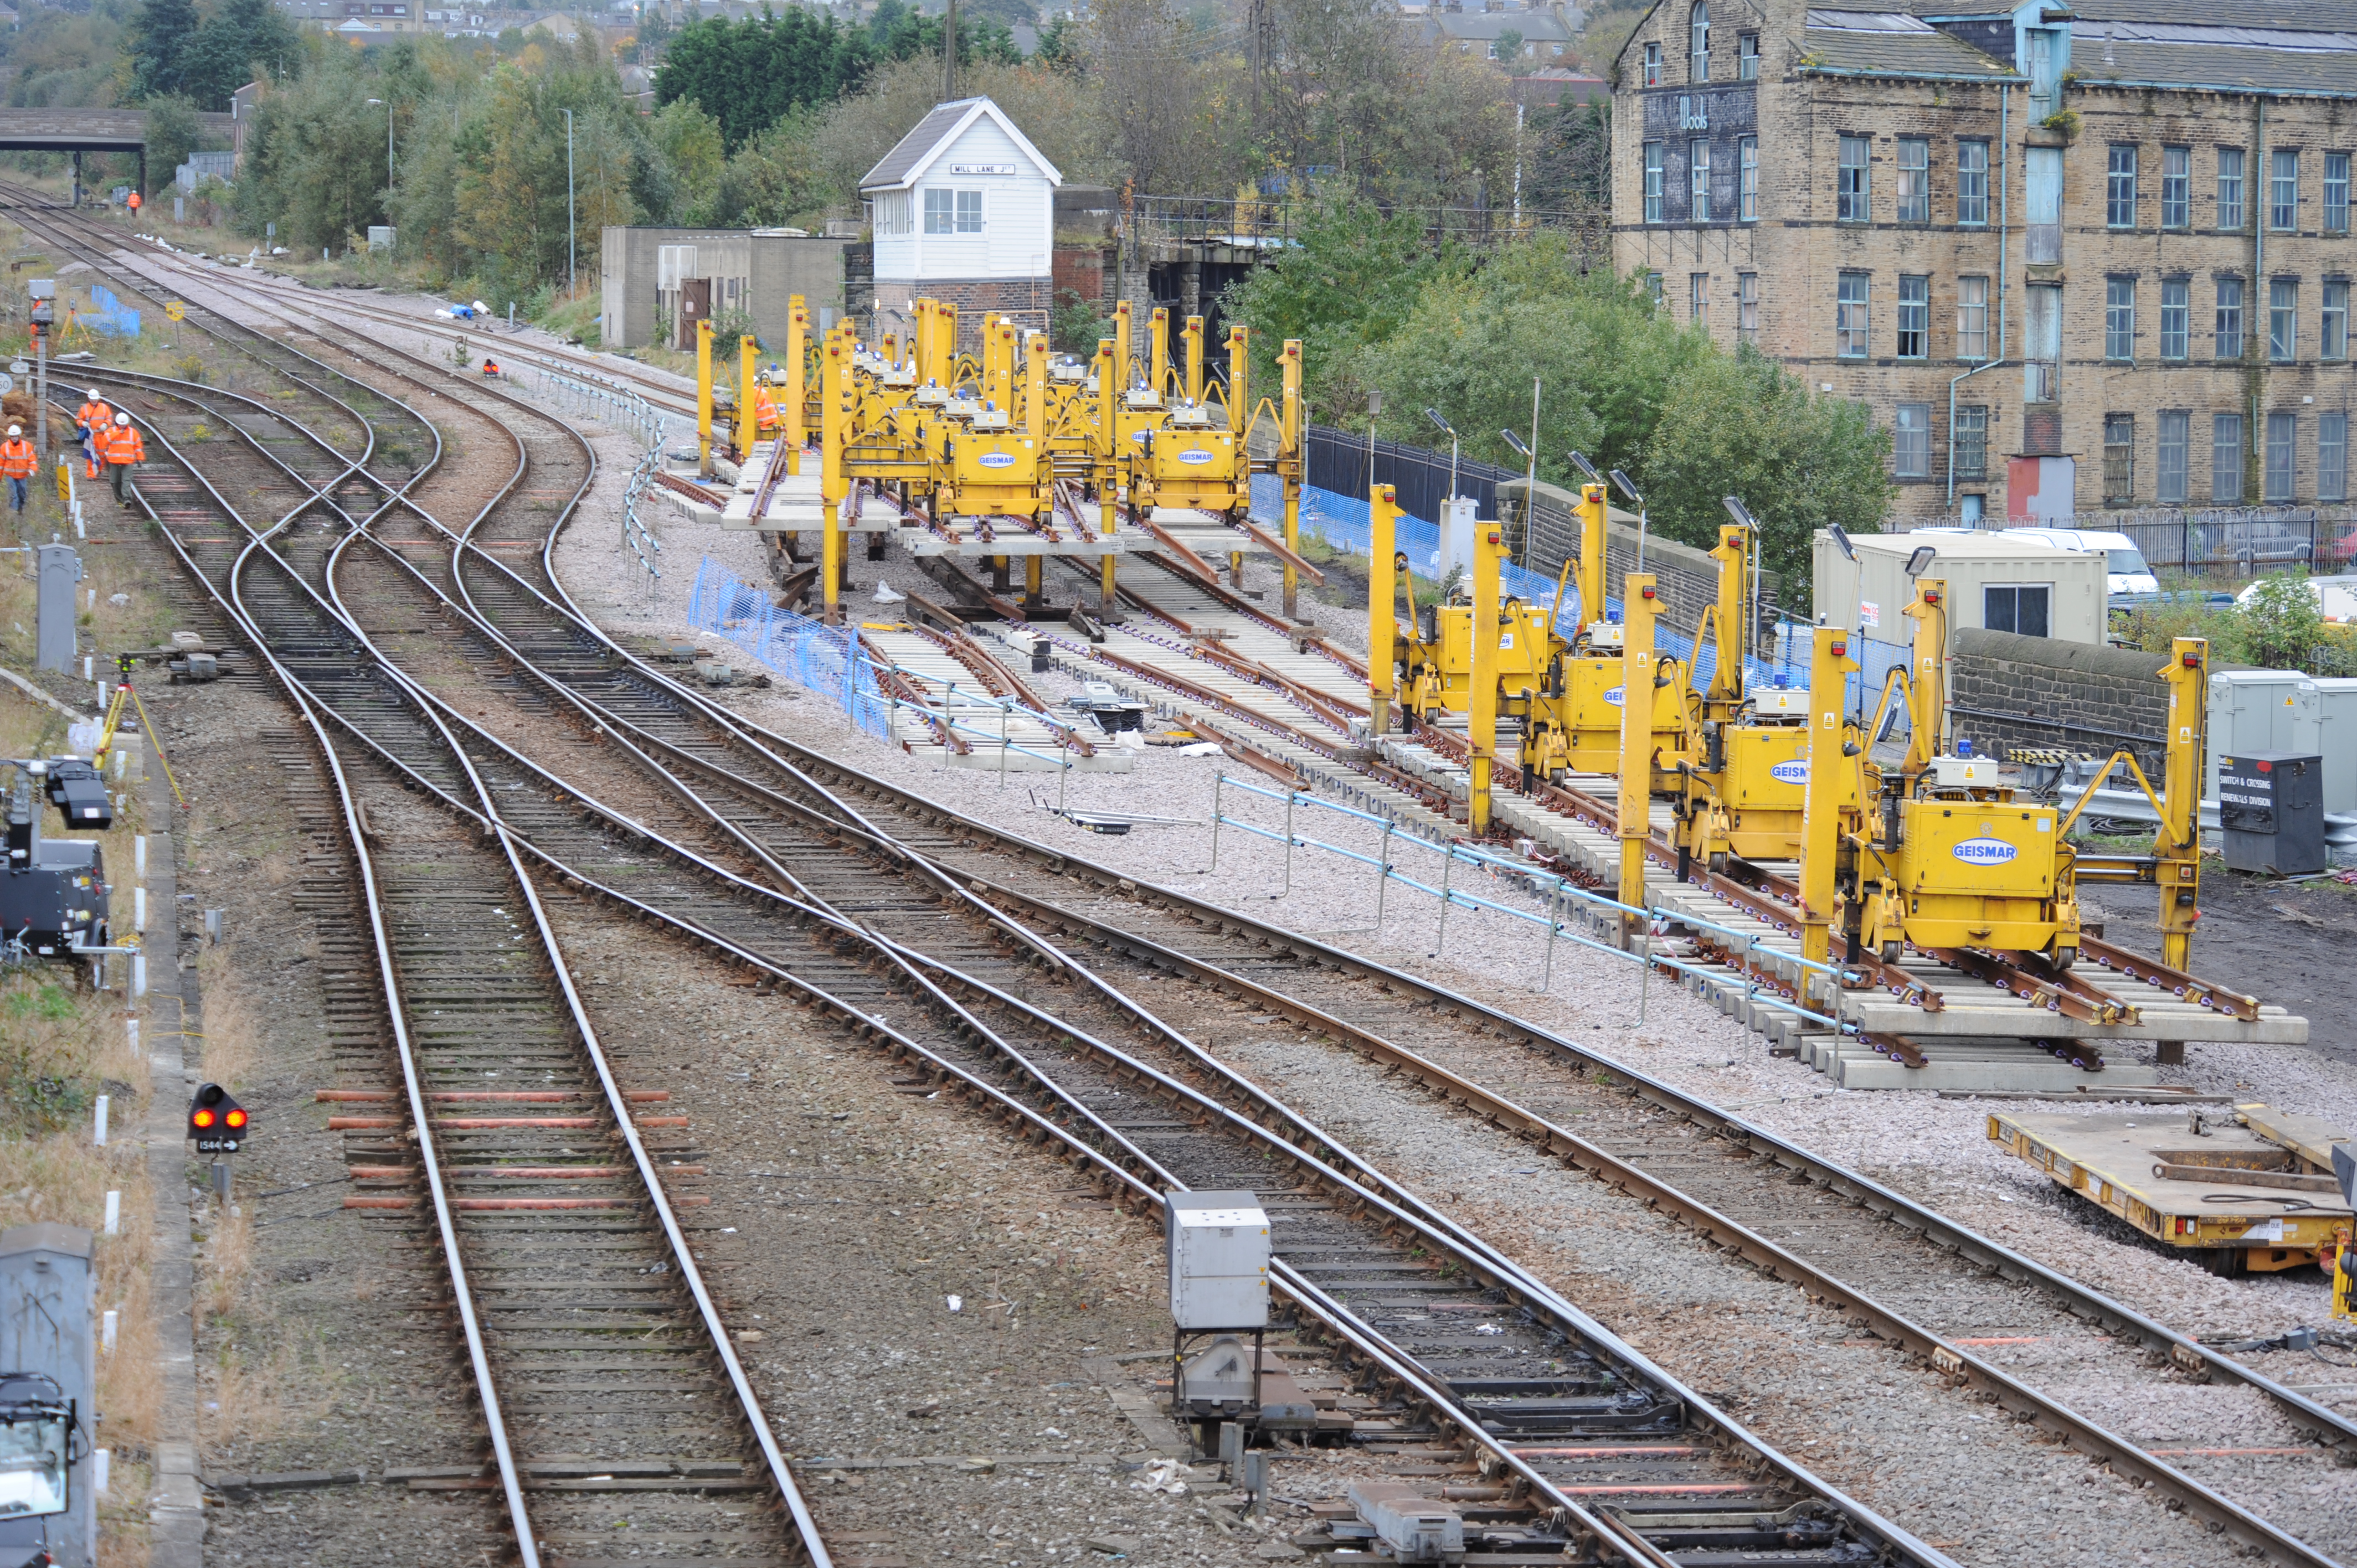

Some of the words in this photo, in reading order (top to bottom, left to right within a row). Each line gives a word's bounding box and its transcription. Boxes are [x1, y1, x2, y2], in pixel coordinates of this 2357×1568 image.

[1680, 96, 1708, 129] Wools
[166, 301, 184, 321] 55
[1772, 766, 1805, 777] GEISM
[2220, 775, 2239, 785] SWITCH
[2240, 777, 2245, 786] &
[2246, 778, 2271, 789] CROSSING
[2249, 796, 2271, 807] DIVISION
[1954, 845, 2016, 859] GEISMAR
[199, 1141, 220, 1149] 1544
